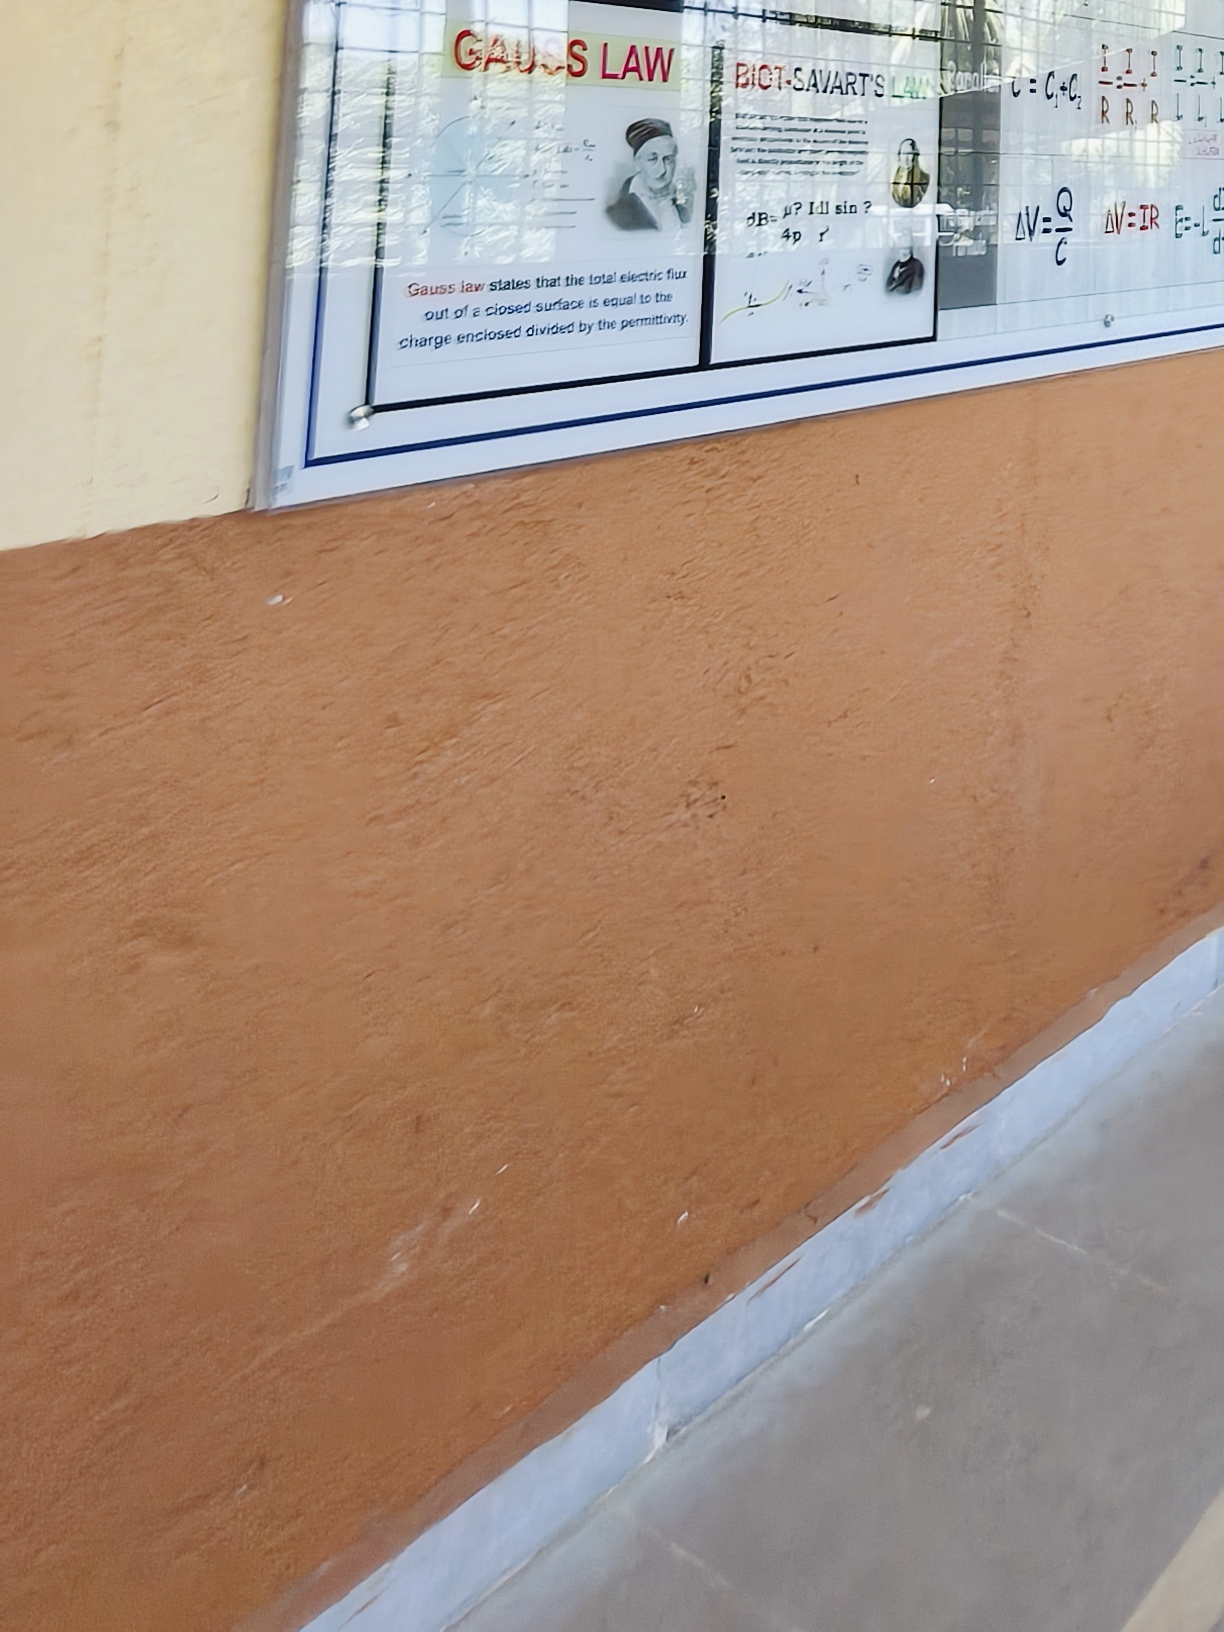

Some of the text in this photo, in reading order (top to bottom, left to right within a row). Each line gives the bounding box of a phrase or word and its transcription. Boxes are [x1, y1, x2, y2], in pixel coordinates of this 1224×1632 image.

[600, 42, 674, 82] LAW
[836, 201, 857, 214] sin
[1056, 186, 1074, 223] Q
[1054, 238, 1068, 266] C
[405, 268, 687, 297] Gauss law states that the total electric flux
[424, 292, 673, 321] out of a closed surface is equal to the
[398, 334, 452, 350] charge
[456, 326, 521, 344] enclosed
[526, 321, 574, 336] divided
[579, 321, 594, 336] by
[598, 319, 617, 330] the
